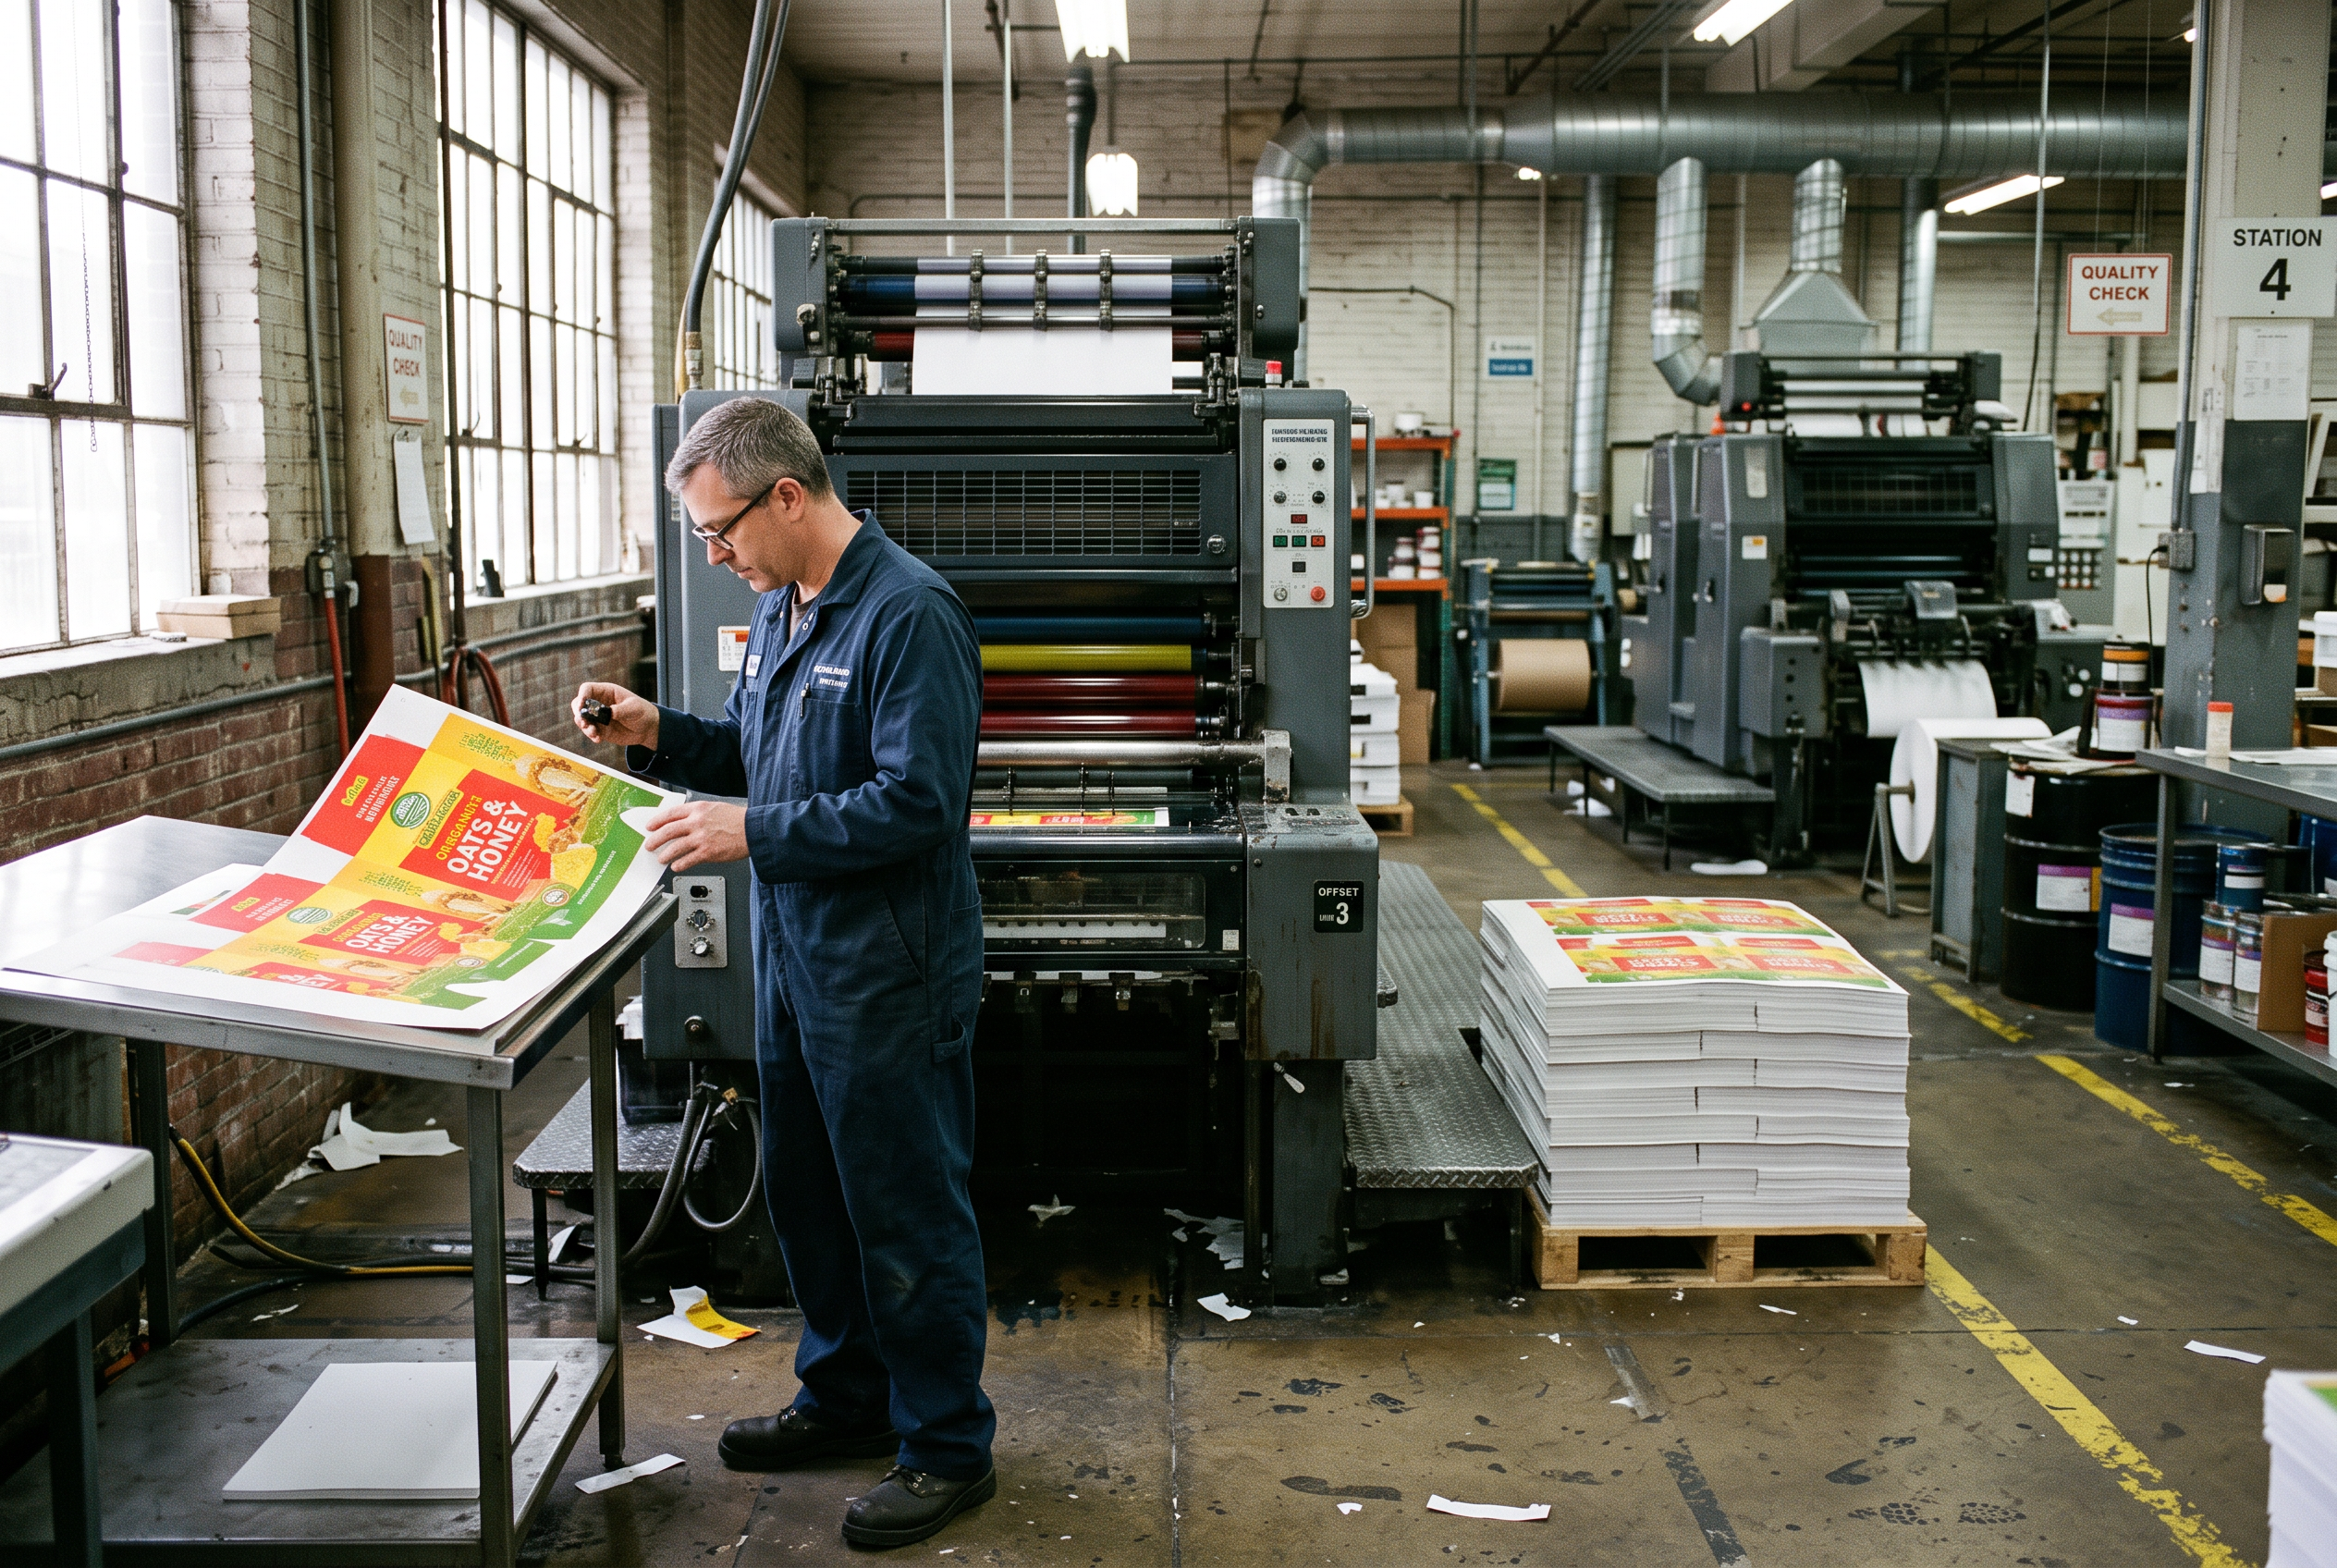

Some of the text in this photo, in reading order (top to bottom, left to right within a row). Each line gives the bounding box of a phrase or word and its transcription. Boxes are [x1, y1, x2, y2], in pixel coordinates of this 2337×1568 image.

[2233, 228, 2322, 247] STATION
[2081, 265, 2159, 279] QUALITY
[2258, 258, 2292, 300] 4
[2088, 287, 2149, 300] CHECK
[389, 329, 422, 349] QUALITY
[393, 358, 421, 376] CHECK
[447, 818, 493, 873] OATS
[483, 800, 507, 815] &
[466, 800, 528, 882] HONEY
[1318, 888, 1359, 896] OFFSET
[1336, 902, 1349, 925] 3
[345, 924, 394, 949] OATS
[381, 915, 410, 925] &
[365, 915, 434, 953] HONEY
